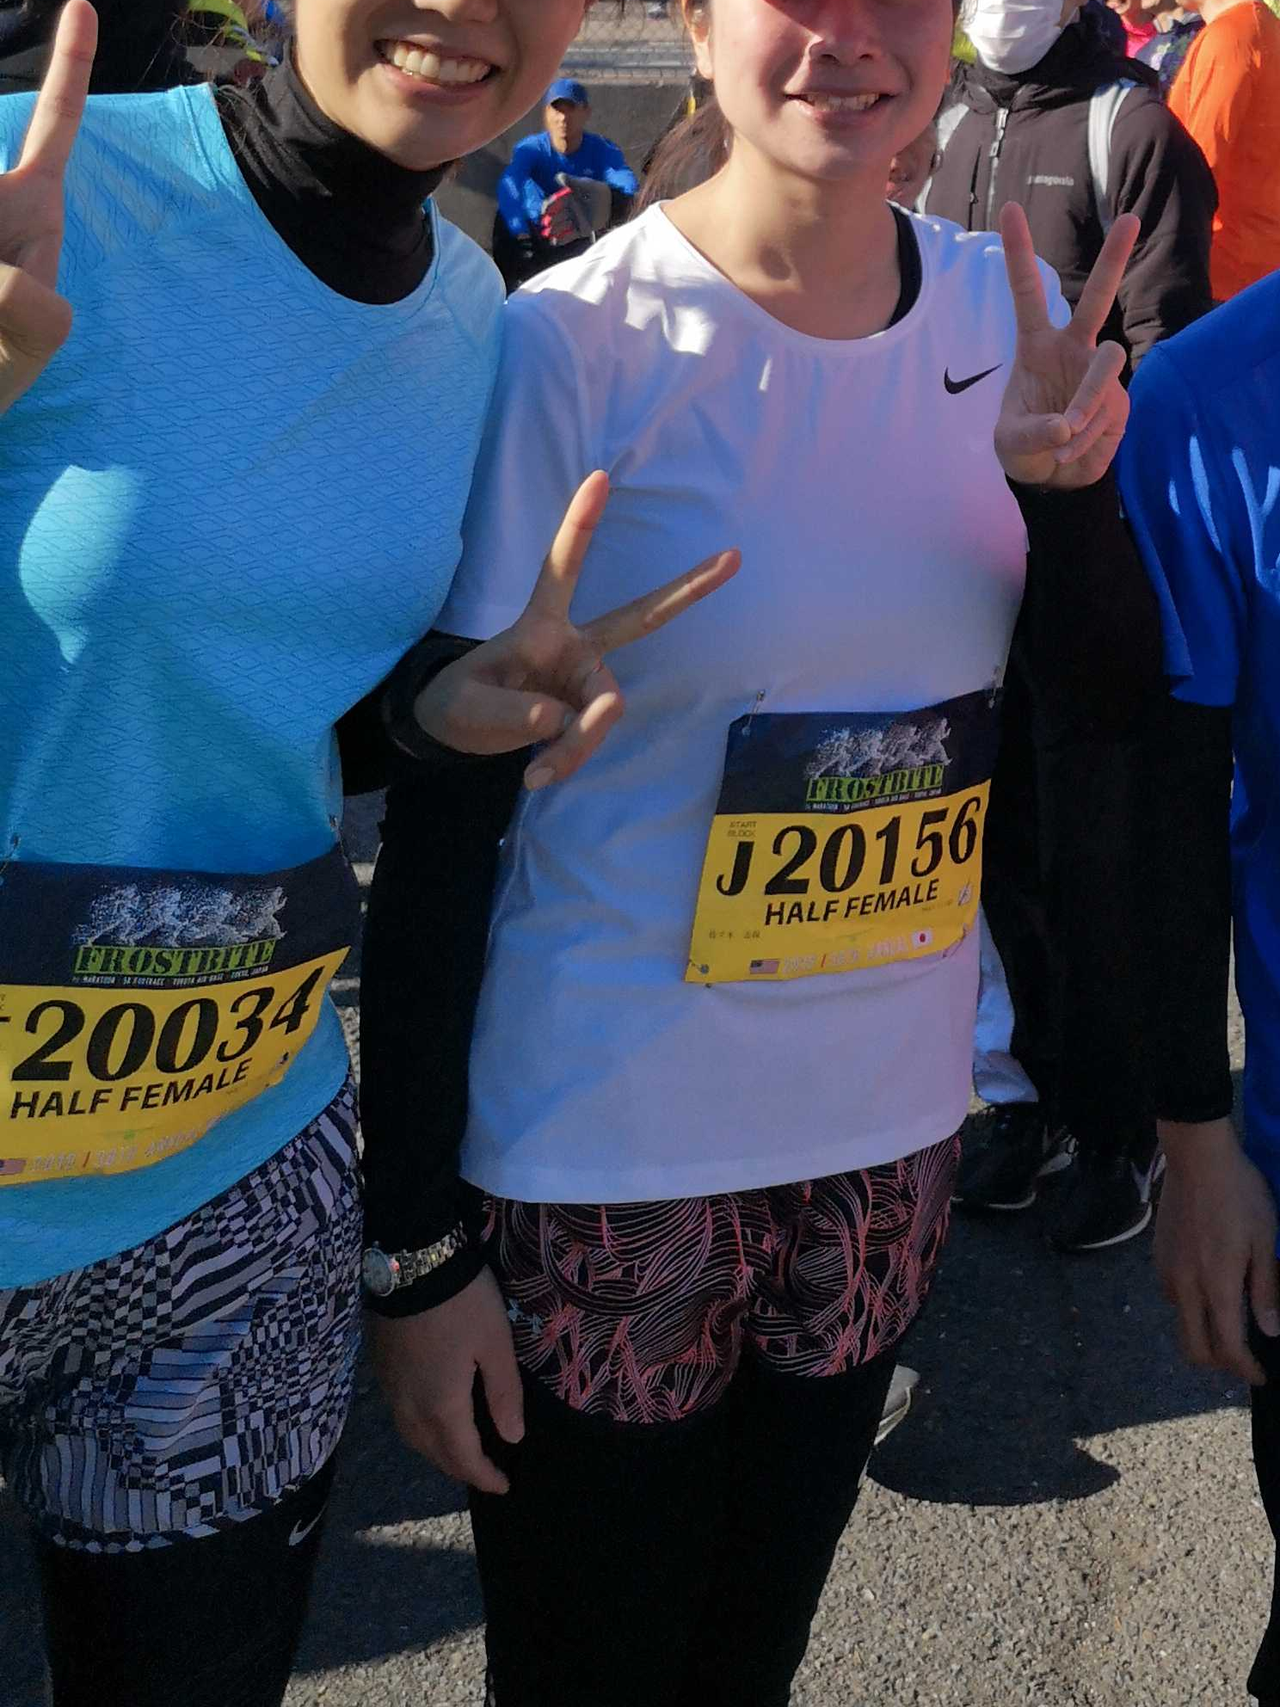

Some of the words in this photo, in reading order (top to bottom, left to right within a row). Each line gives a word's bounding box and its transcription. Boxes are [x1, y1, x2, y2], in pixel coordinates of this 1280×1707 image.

[809, 764, 943, 802] FROSTBITE
[764, 796, 982, 896] 20156
[765, 899, 840, 926] HALF
[843, 878, 940, 919] FEMALE
[77, 940, 275, 975] FROSTBITE
[11, 965, 325, 1082] 20034
[10, 1087, 113, 1119] HALF
[119, 1058, 253, 1112] FEMALE
